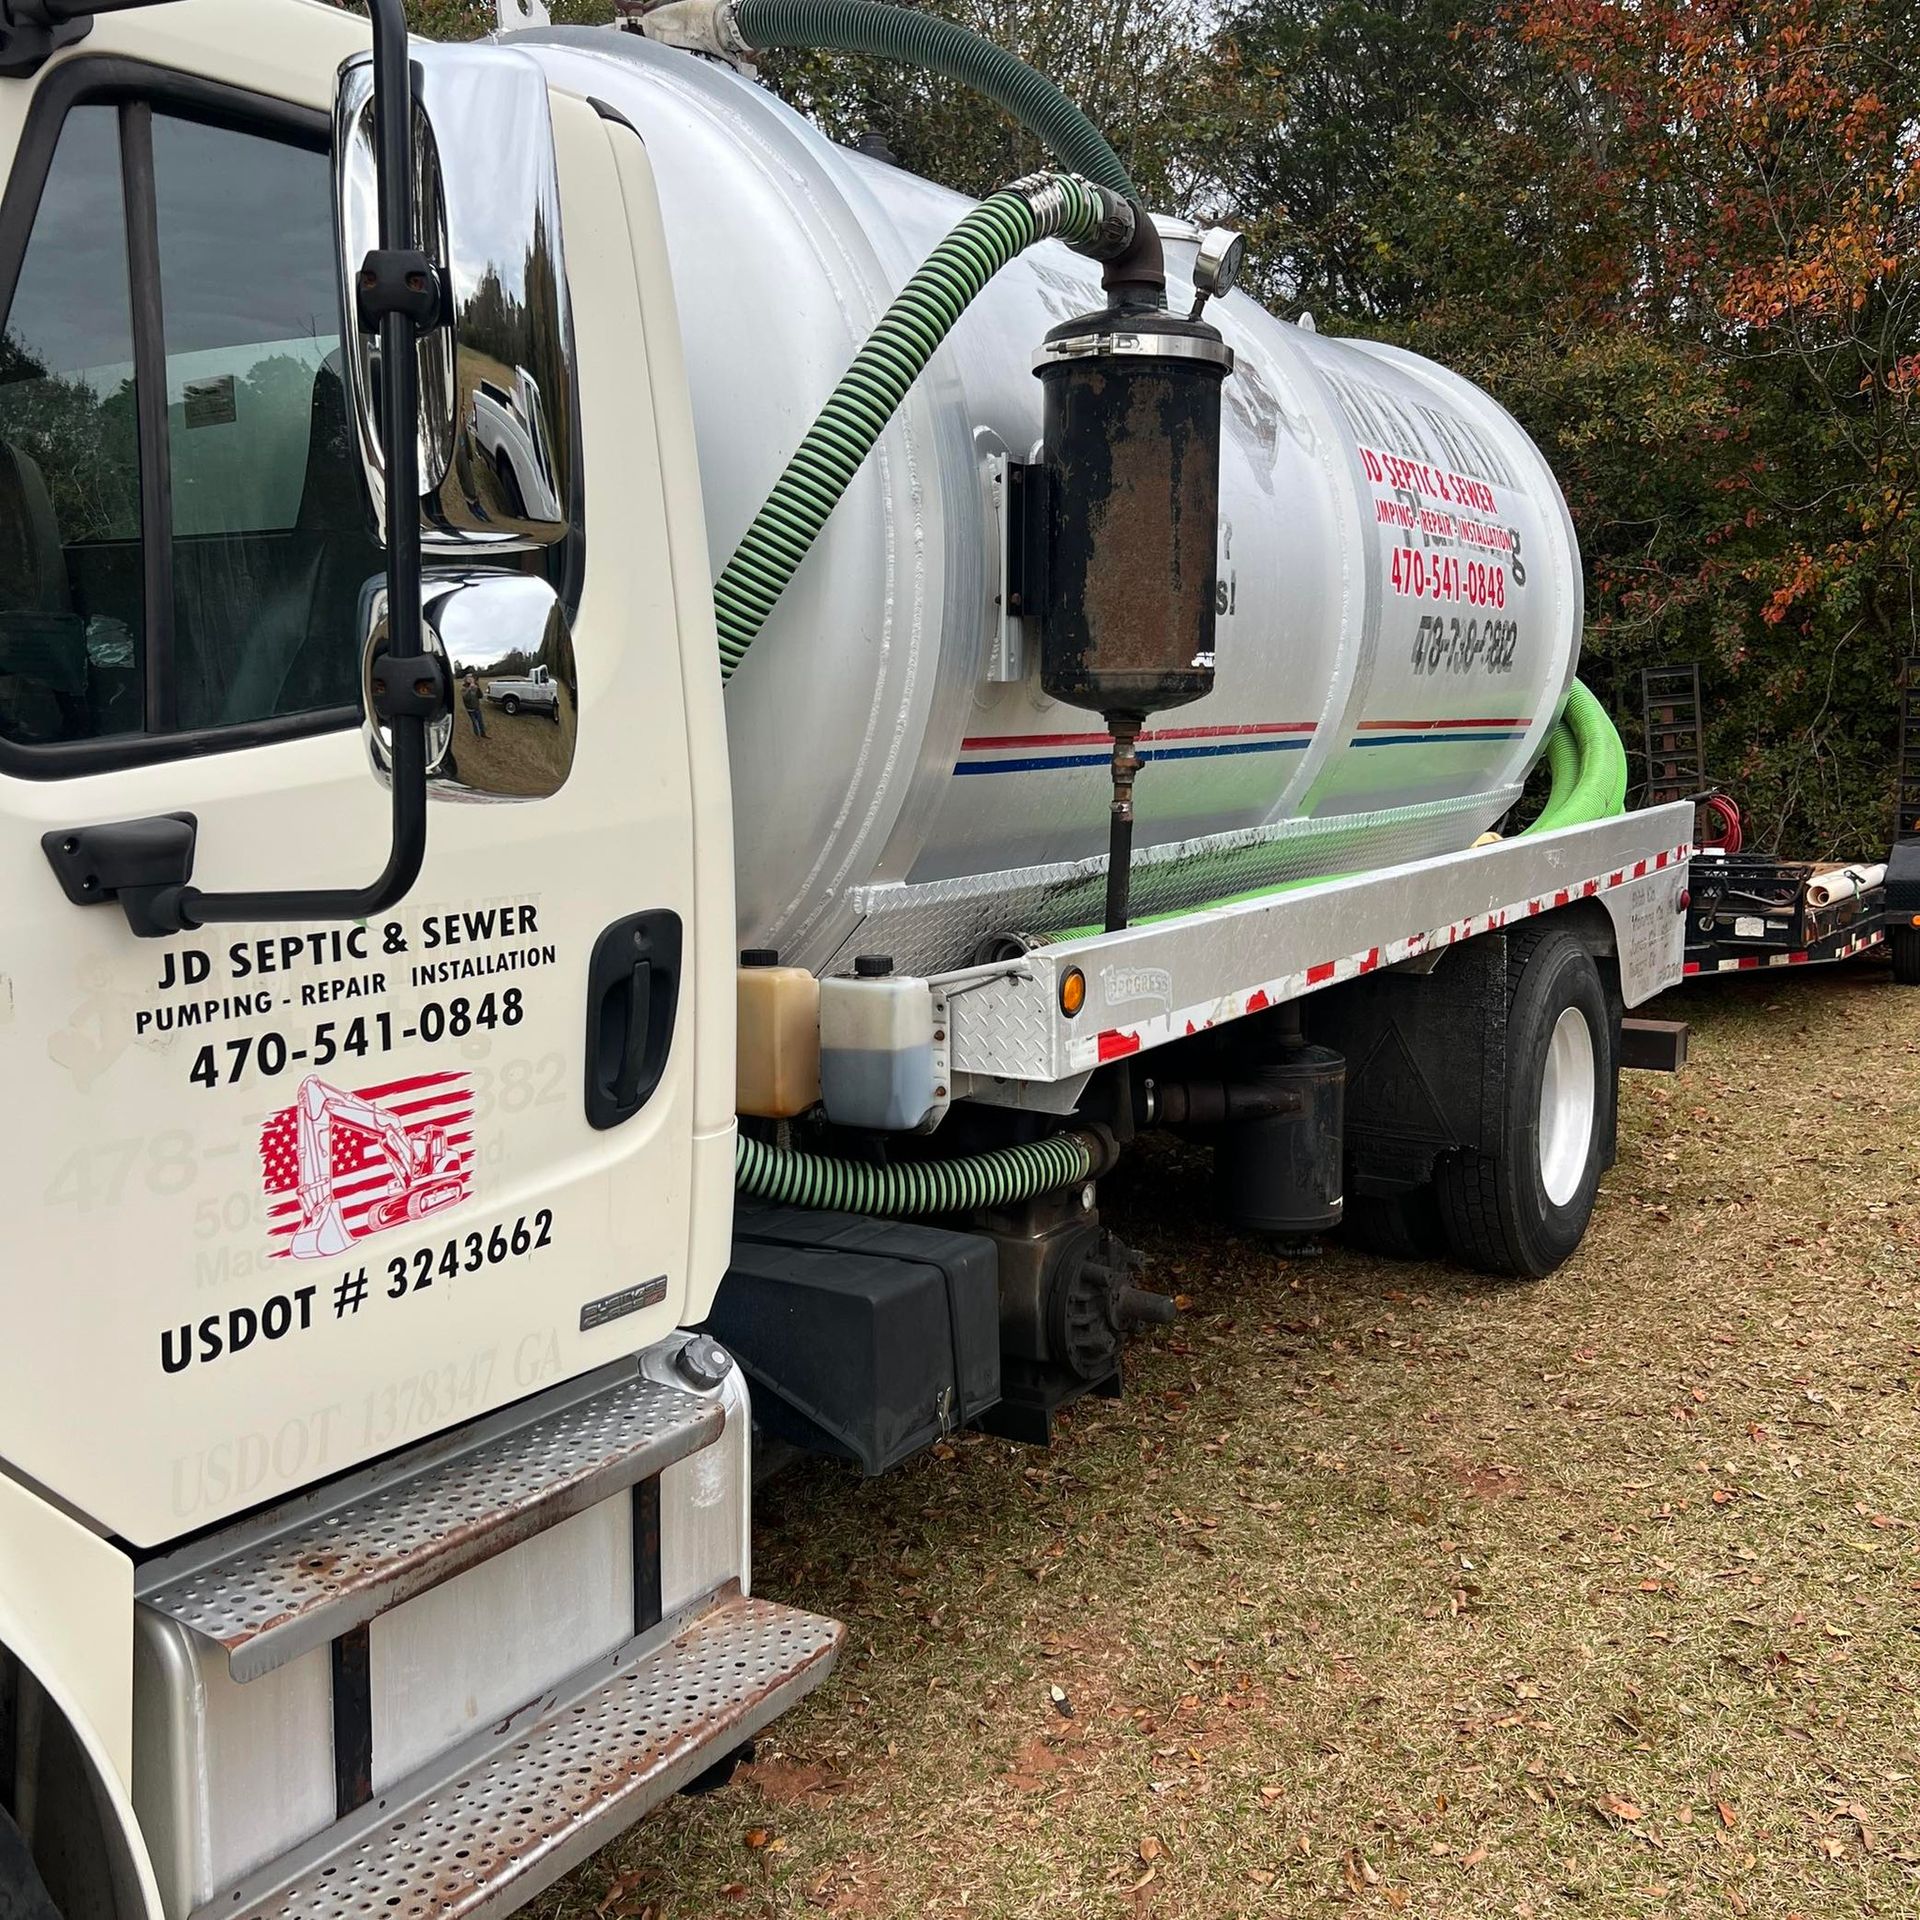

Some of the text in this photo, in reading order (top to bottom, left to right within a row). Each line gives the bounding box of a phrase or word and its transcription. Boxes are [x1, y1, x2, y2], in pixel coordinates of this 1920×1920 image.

[1381, 453, 1438, 498] SEPTIC
[1434, 469, 1452, 501] &
[1448, 473, 1498, 514] SEWER
[1420, 509, 1453, 537] REPAIR
[1458, 519, 1513, 551] INSTALLATION
[1391, 547, 1505, 609] 470-541-0848
[136, 991, 272, 1035] PUMPING
[301, 972, 387, 1006] REPAIR
[412, 944, 556, 987] INSTALLATION
[158, 904, 539, 990] JD SEPTIC & SEWER
[189, 987, 524, 1089] 470-541-0848
[161, 1208, 553, 1374] USDOT # 3243662
[170, 1326, 563, 1518] USDOT 1378347 GA
